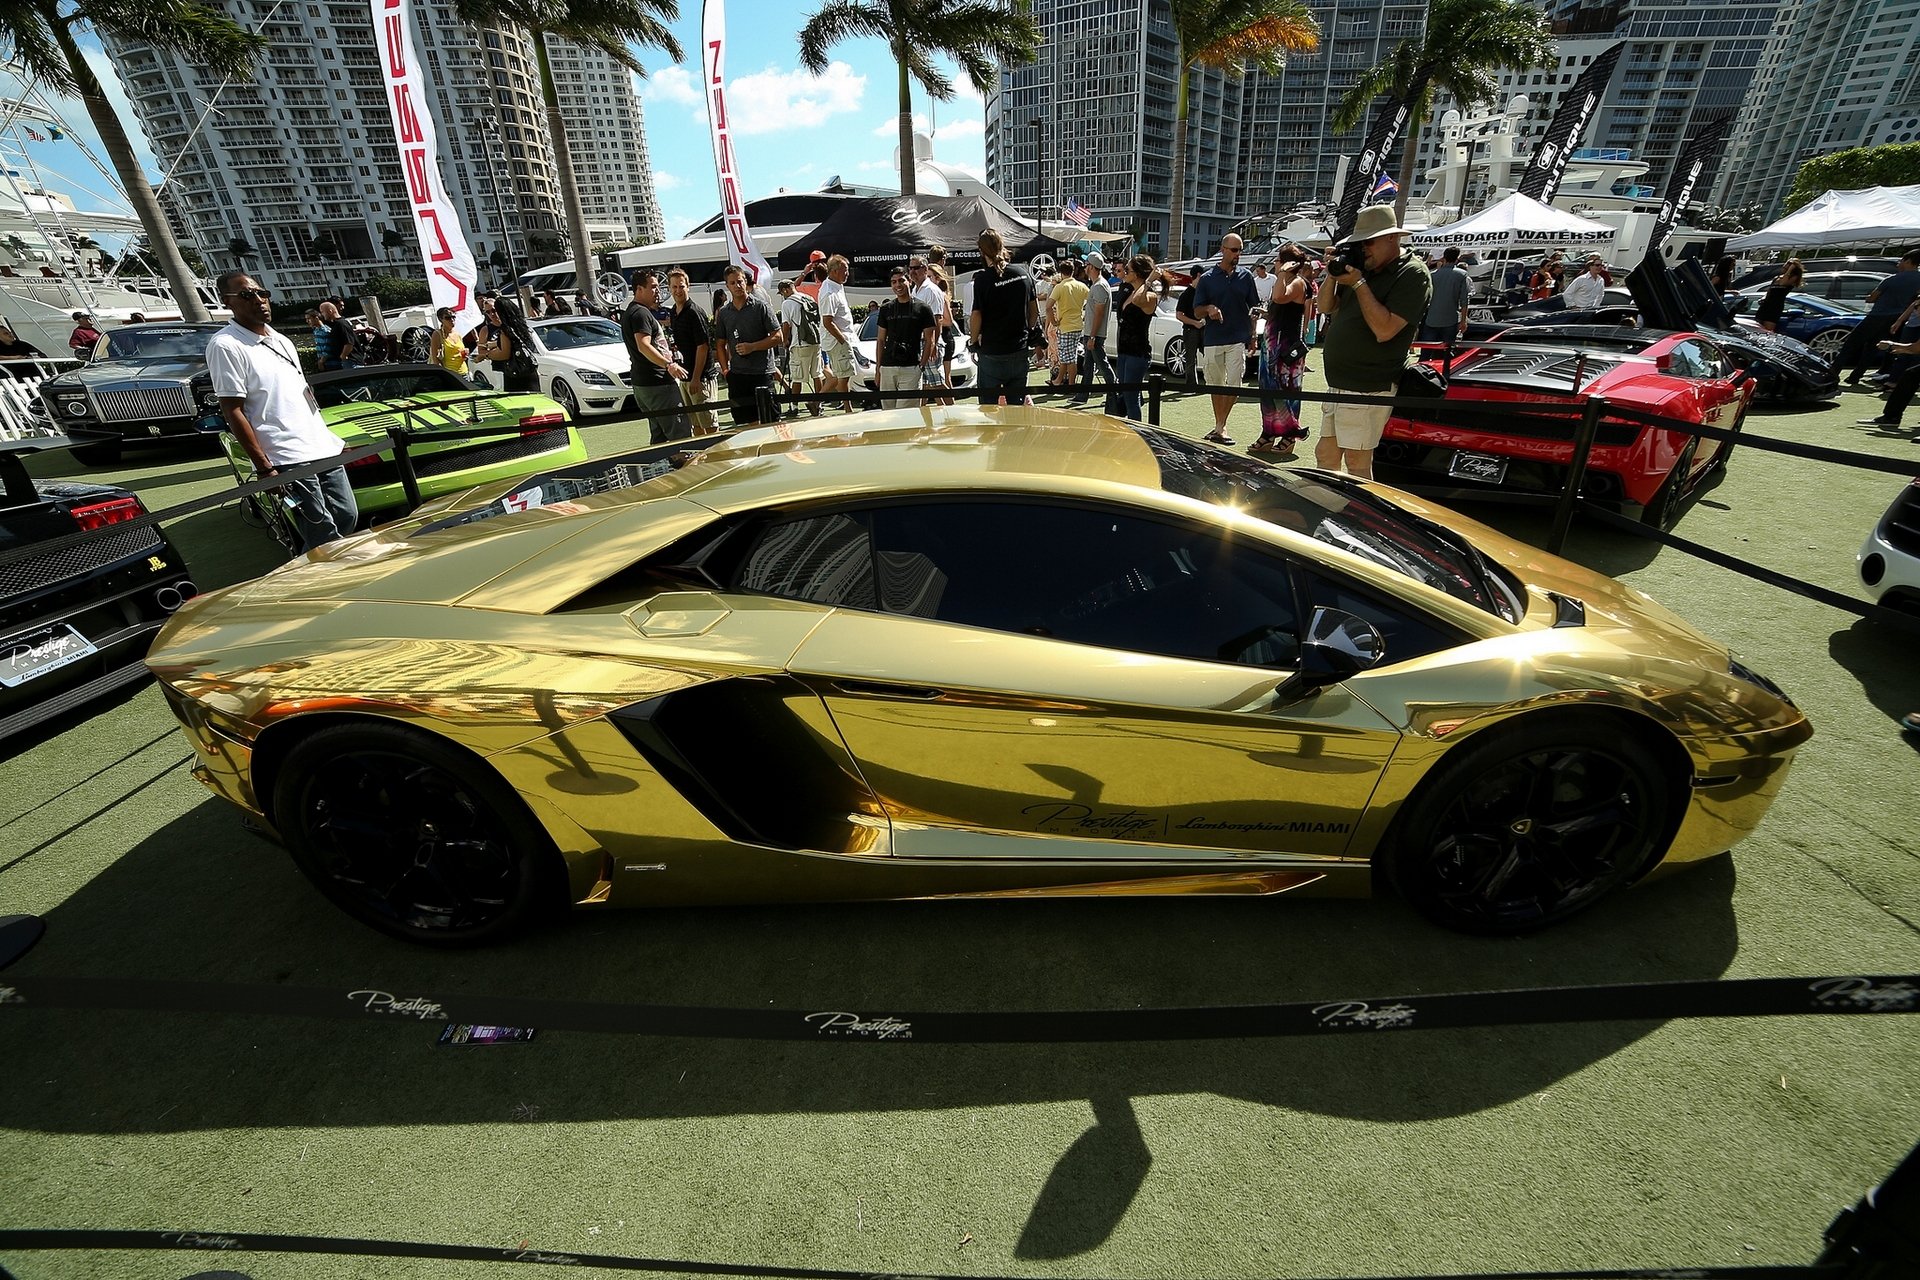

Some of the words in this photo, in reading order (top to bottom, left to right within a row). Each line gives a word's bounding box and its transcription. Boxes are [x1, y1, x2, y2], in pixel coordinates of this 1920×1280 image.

[384, 0, 467, 312] VOSSE
[1540, 91, 1596, 203] AUTIQUE
[1656, 158, 1703, 249] AUTIQUE
[1411, 231, 1509, 243] WAKEBOARD
[1516, 230, 1615, 240] WATERSKI
[854, 253, 908, 263] DISTINGUISHED
[954, 251, 981, 259] ACCESS
[0, 636, 70, 667] Prestige
[1021, 802, 1158, 839] Prestige
[1176, 816, 1288, 832] Lamborghini
[1288, 821, 1350, 834] MIAMI
[347, 989, 441, 1020] Prestige
[804, 1011, 911, 1039] Prestige
